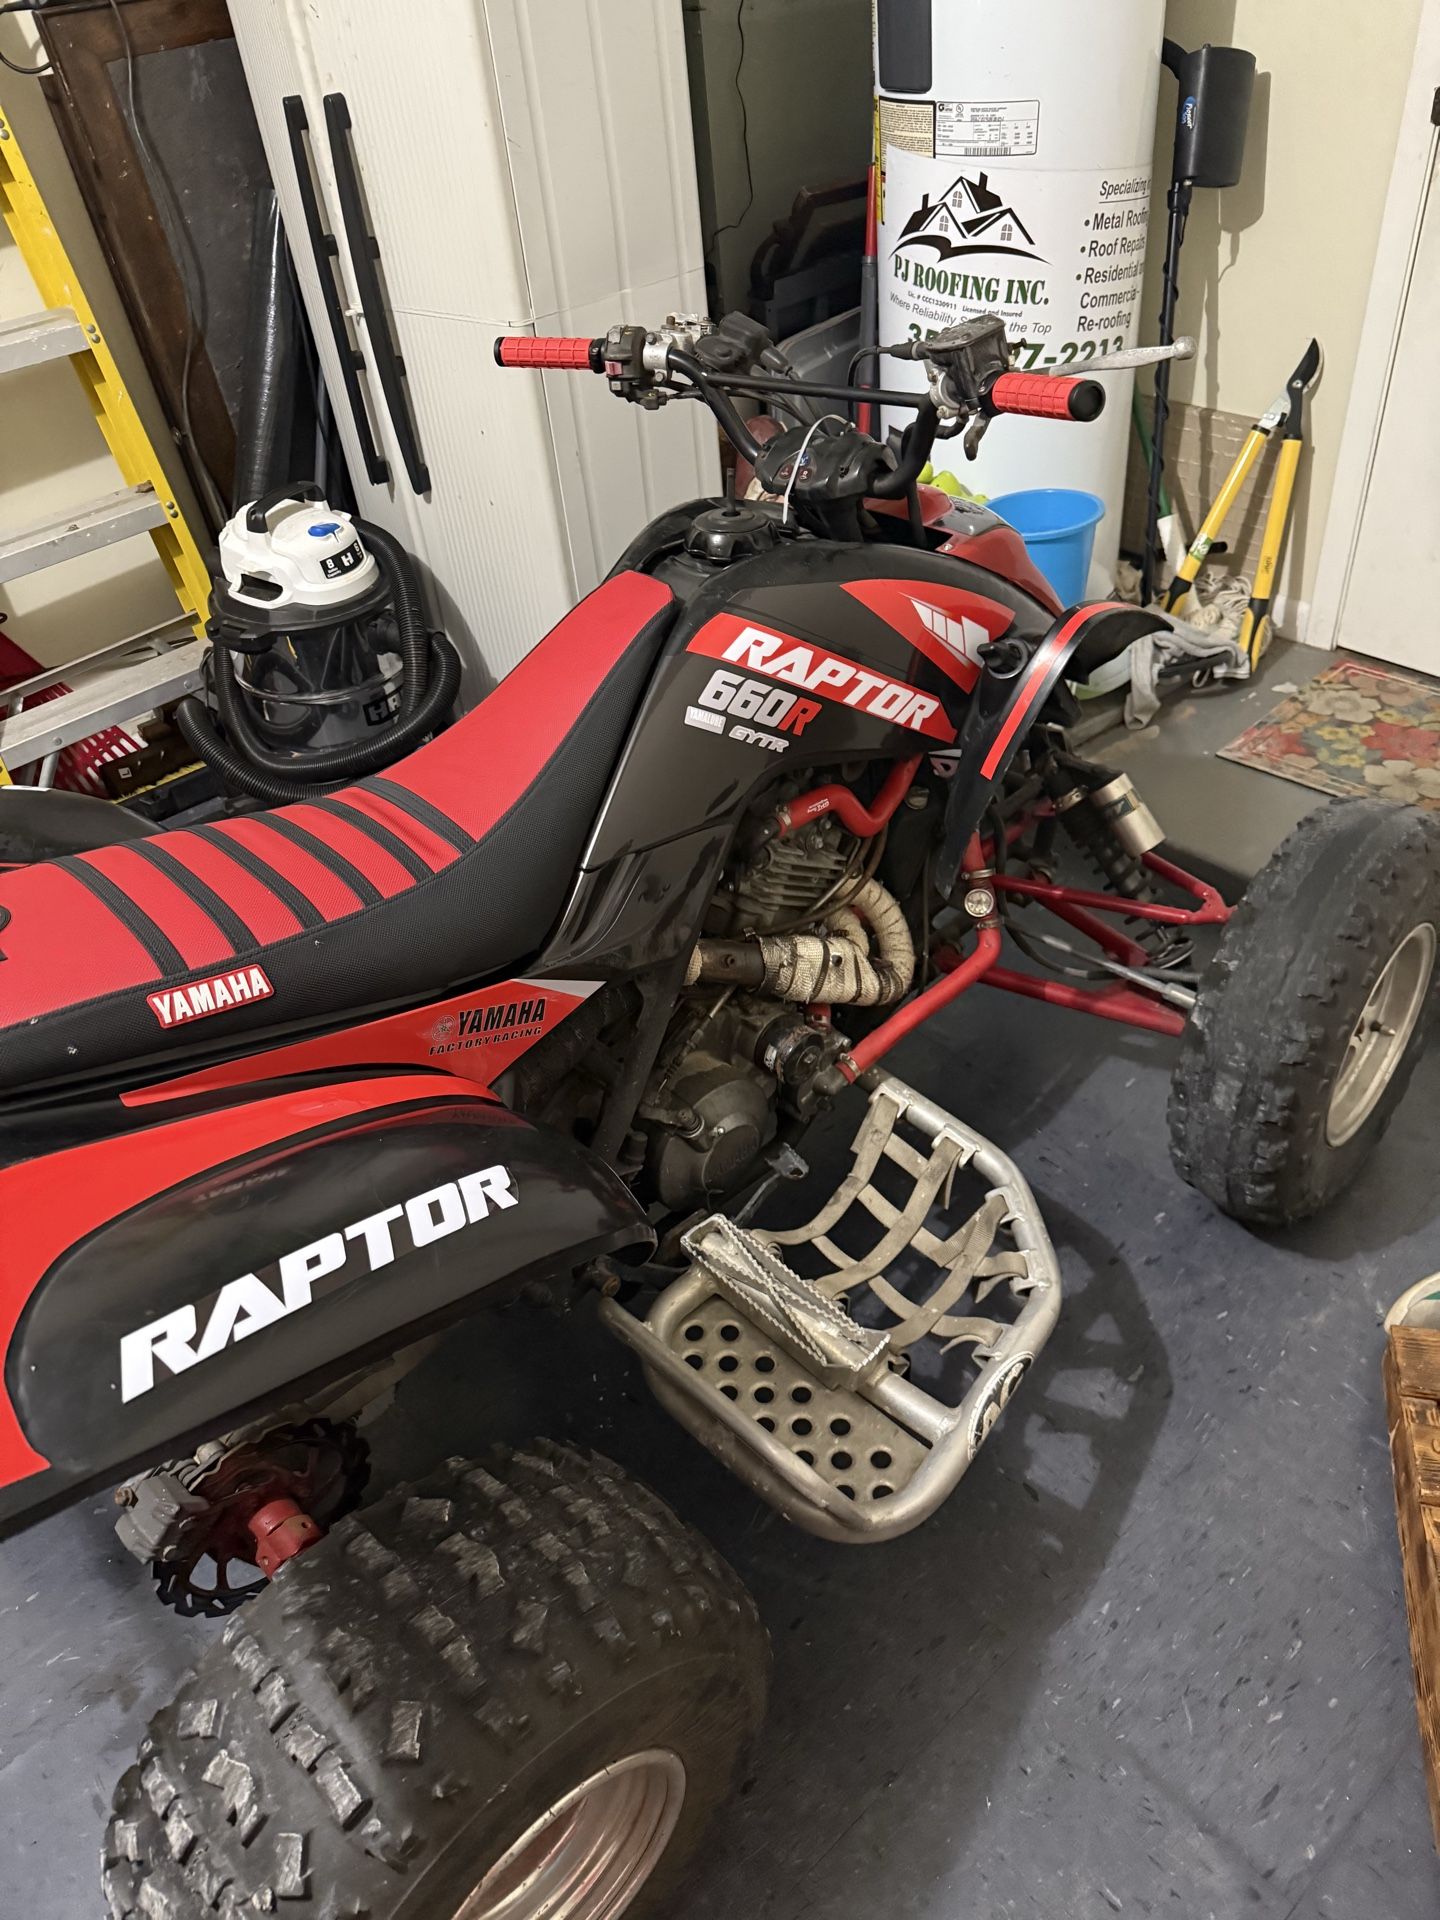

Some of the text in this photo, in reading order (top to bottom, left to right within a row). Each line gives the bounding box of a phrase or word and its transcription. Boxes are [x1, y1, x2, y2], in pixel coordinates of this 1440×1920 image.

[1100, 177, 1146, 199] Specializing
[1092, 210, 1124, 231] Metal
[1088, 237, 1119, 258] Roof
[894, 254, 1049, 305] PJ ROOFING INC.
[1084, 260, 1139, 284] Residential
[890, 290, 957, 326] Where Reliability
[962, 305, 987, 315] Licensed
[1000, 310, 1023, 318] Insured
[1077, 310, 1131, 332] Re-roofing
[1008, 321, 1052, 335] the Top
[325, 558, 335, 569] 8
[721, 626, 939, 731] RAPTOR
[698, 669, 822, 736] 660R
[728, 725, 789, 752] GYTR
[152, 968, 270, 1024] YAMAHA
[458, 999, 546, 1036] YAMAHA
[429, 1026, 542, 1056] FACTORY RACING
[120, 1164, 519, 1404] RAPTOR
